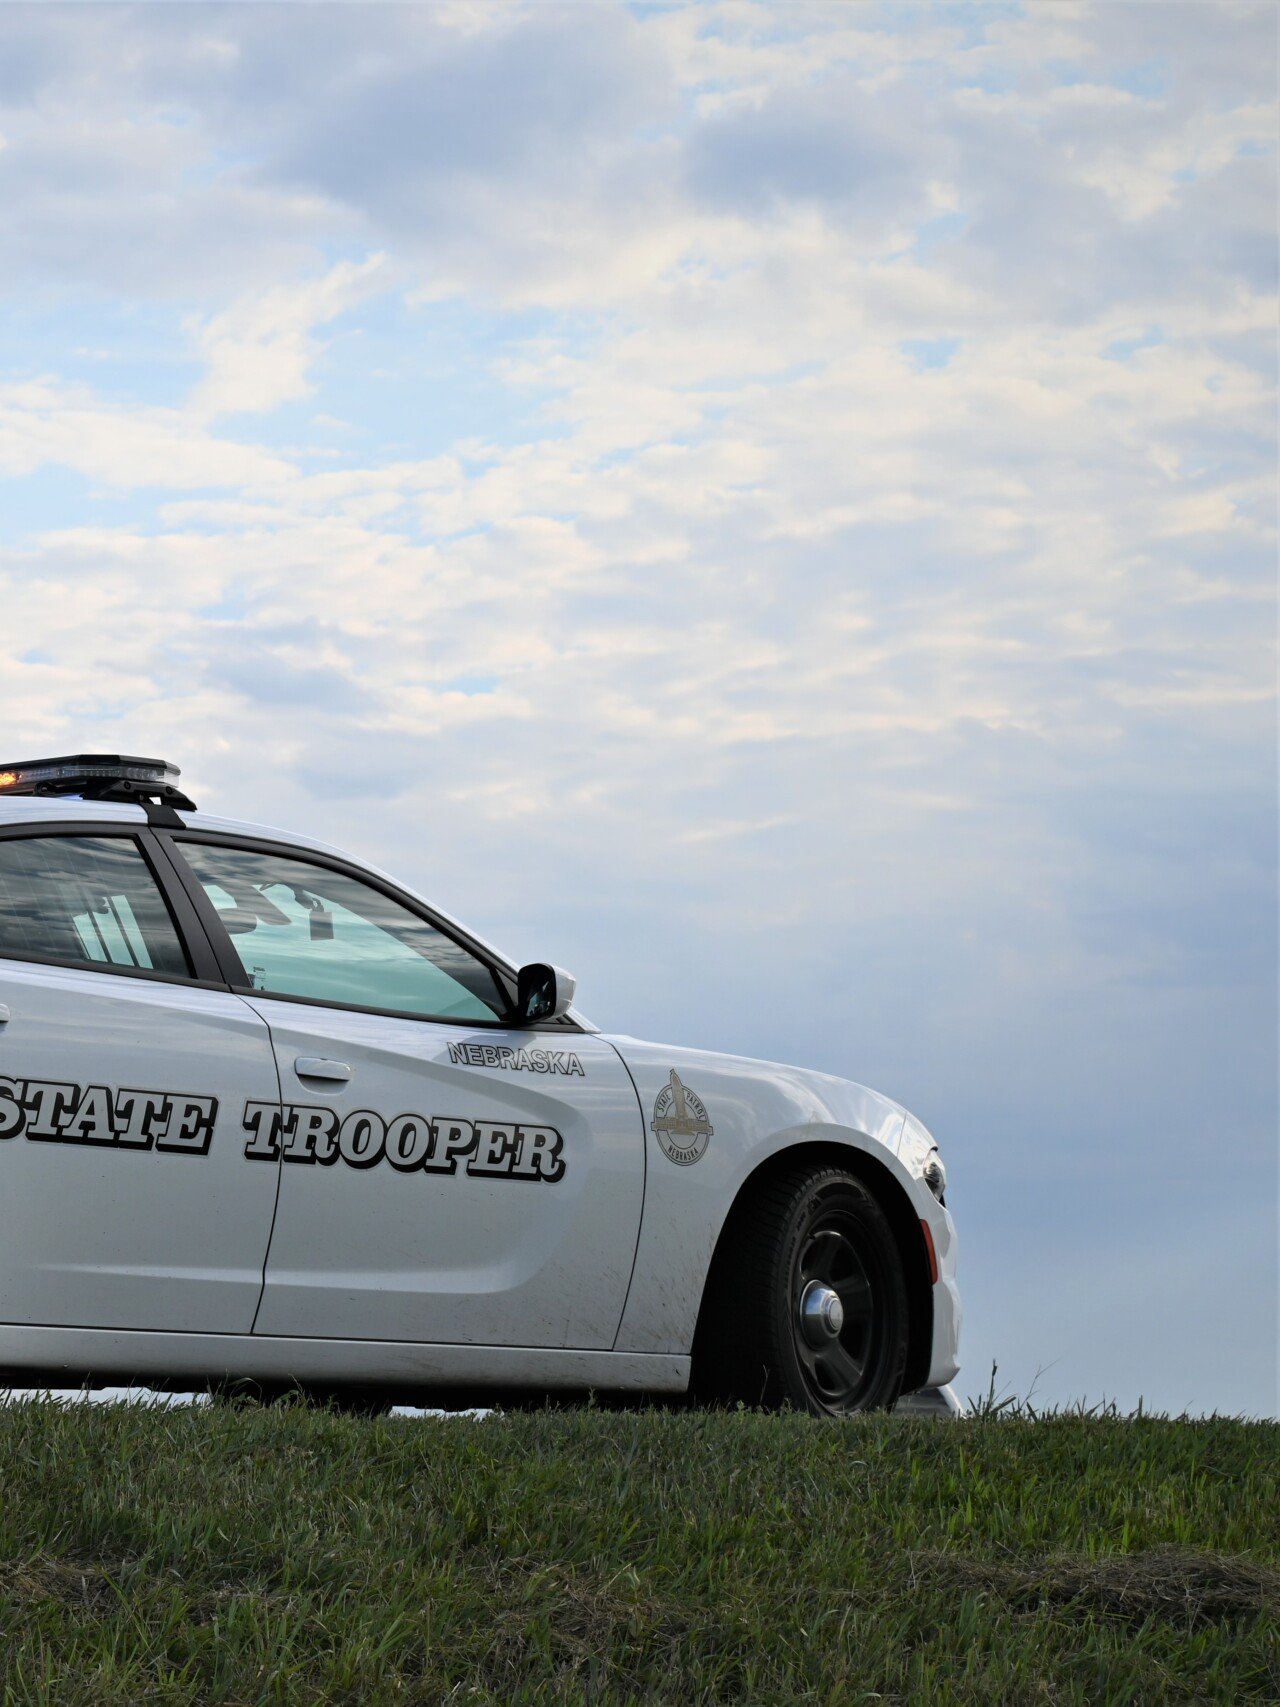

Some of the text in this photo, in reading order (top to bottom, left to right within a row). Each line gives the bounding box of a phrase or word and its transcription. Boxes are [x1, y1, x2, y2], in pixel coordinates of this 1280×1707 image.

[447, 1042, 585, 1076] NEBRASKA
[658, 1092, 707, 1119] STATE PATROL
[242, 1100, 566, 1184] TROOPER
[668, 1145, 699, 1160] NEBRASKA
